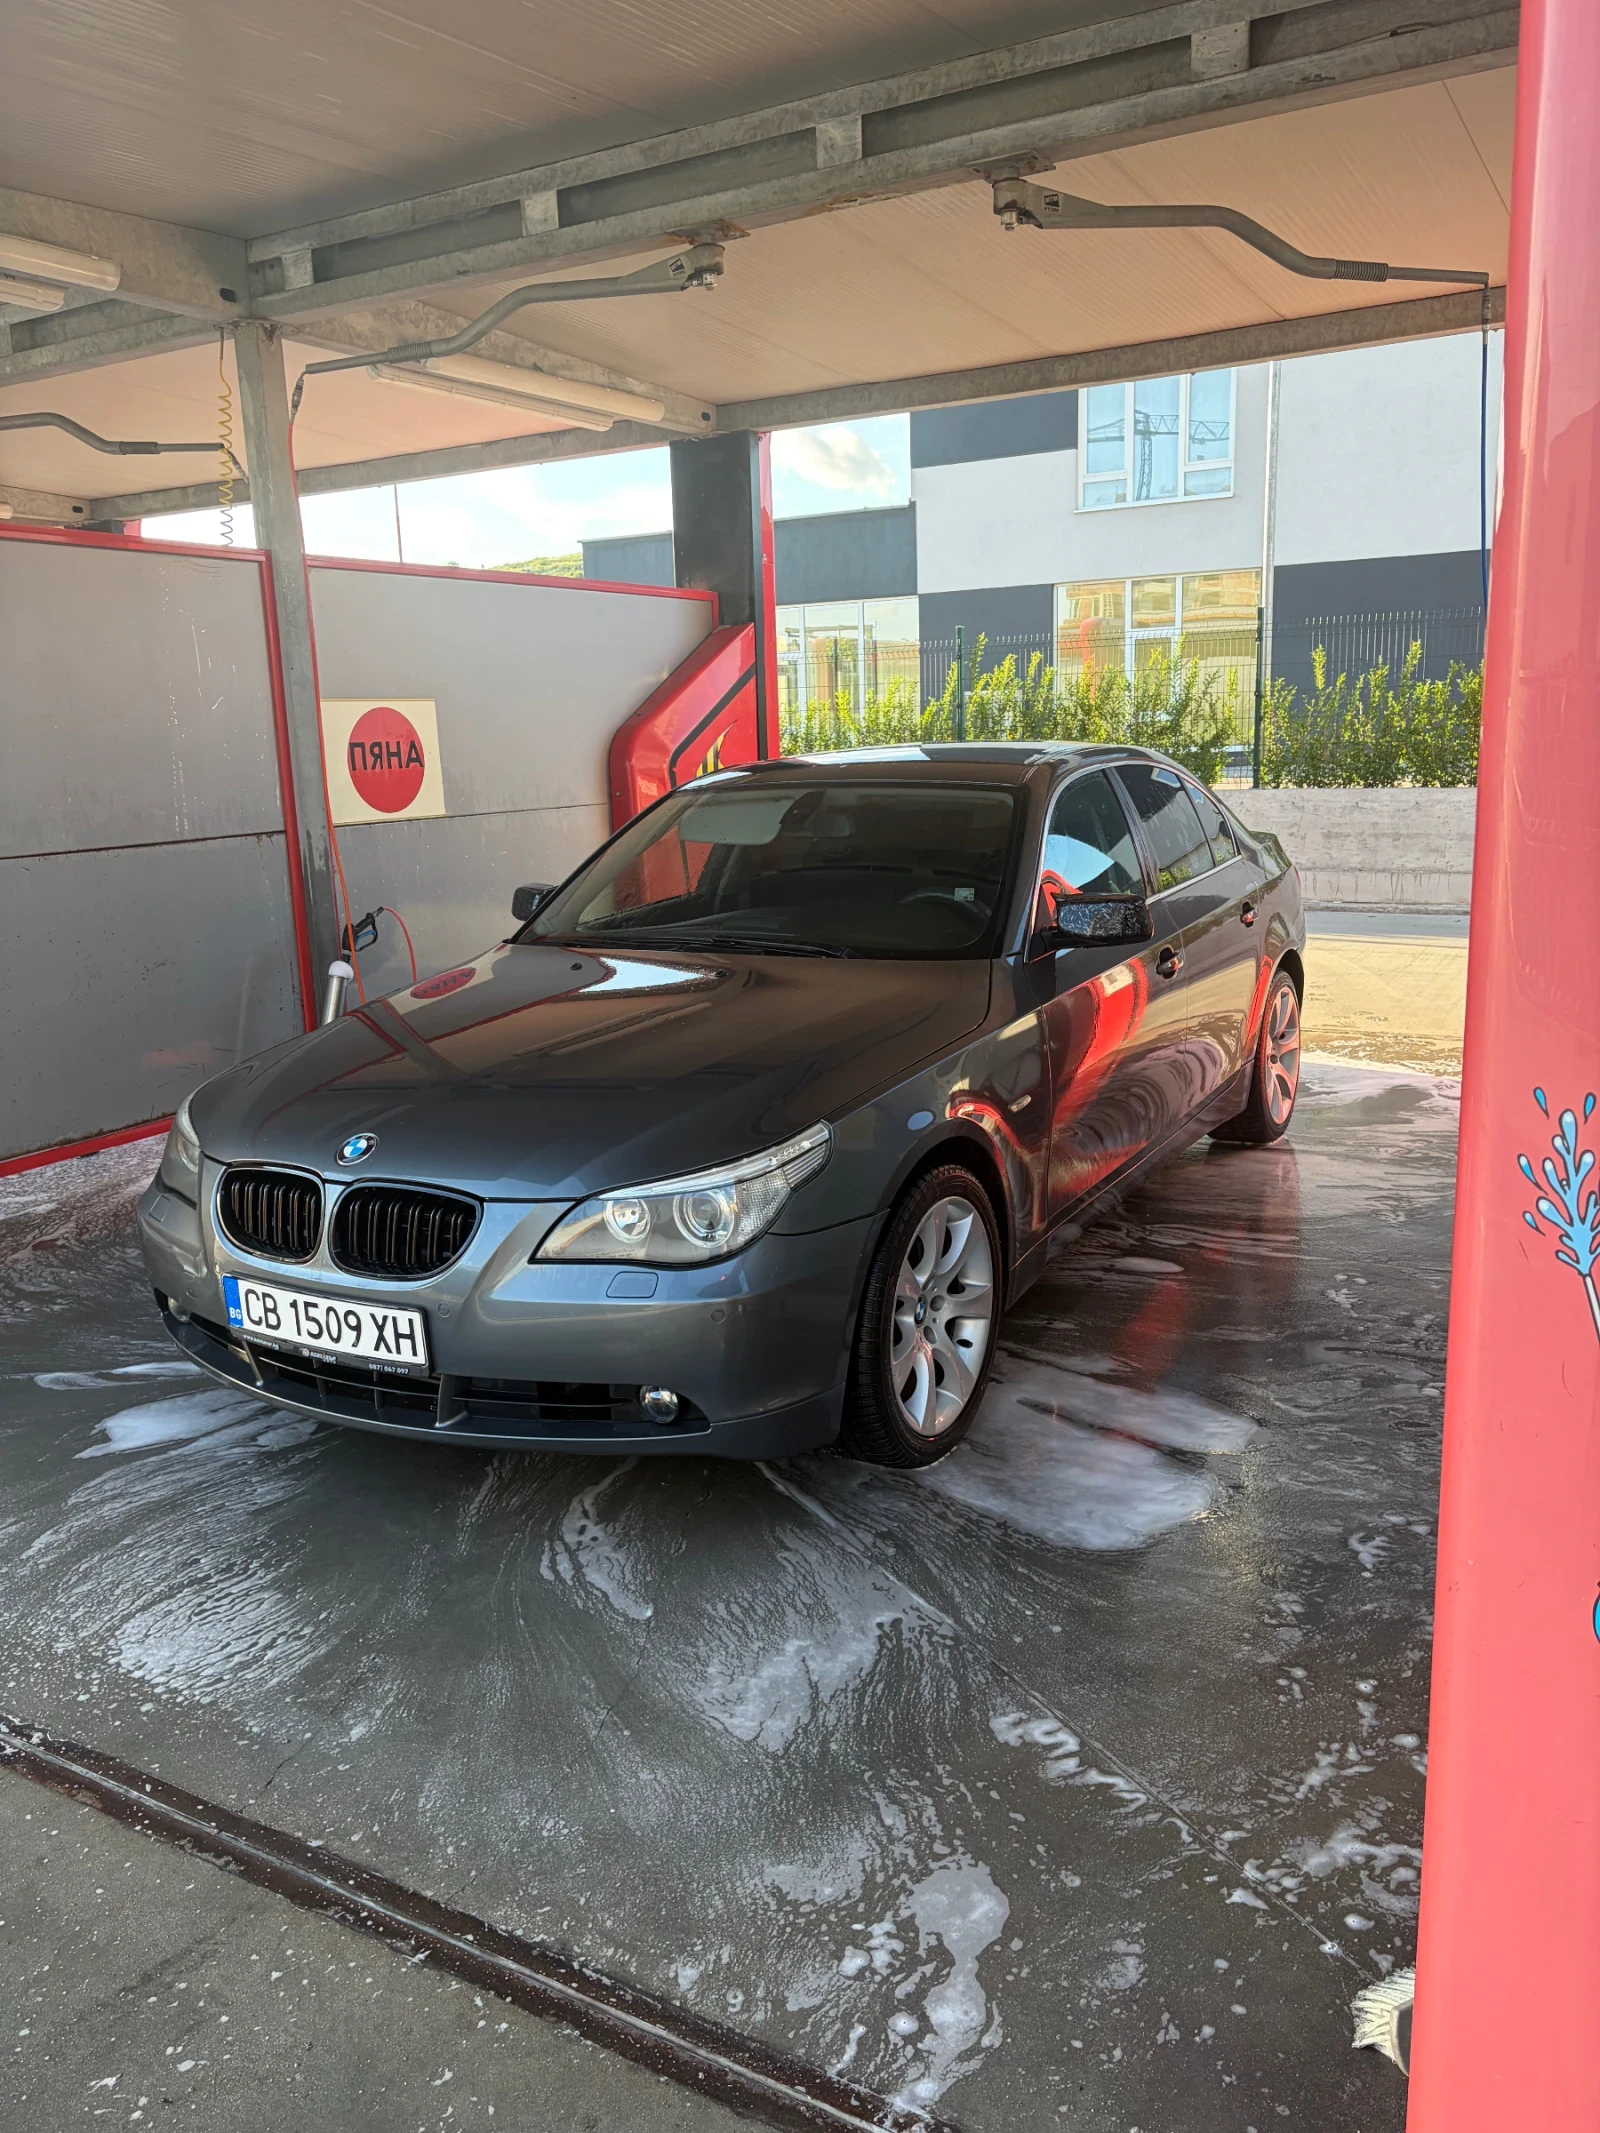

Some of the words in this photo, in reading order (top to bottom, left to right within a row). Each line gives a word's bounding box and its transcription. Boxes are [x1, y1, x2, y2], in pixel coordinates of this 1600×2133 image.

[348, 740, 424, 771] ПЯНА
[229, 1307, 242, 1320] BG
[244, 1288, 281, 1331] CB
[289, 1298, 362, 1348] 1509
[369, 1312, 418, 1357] XH
